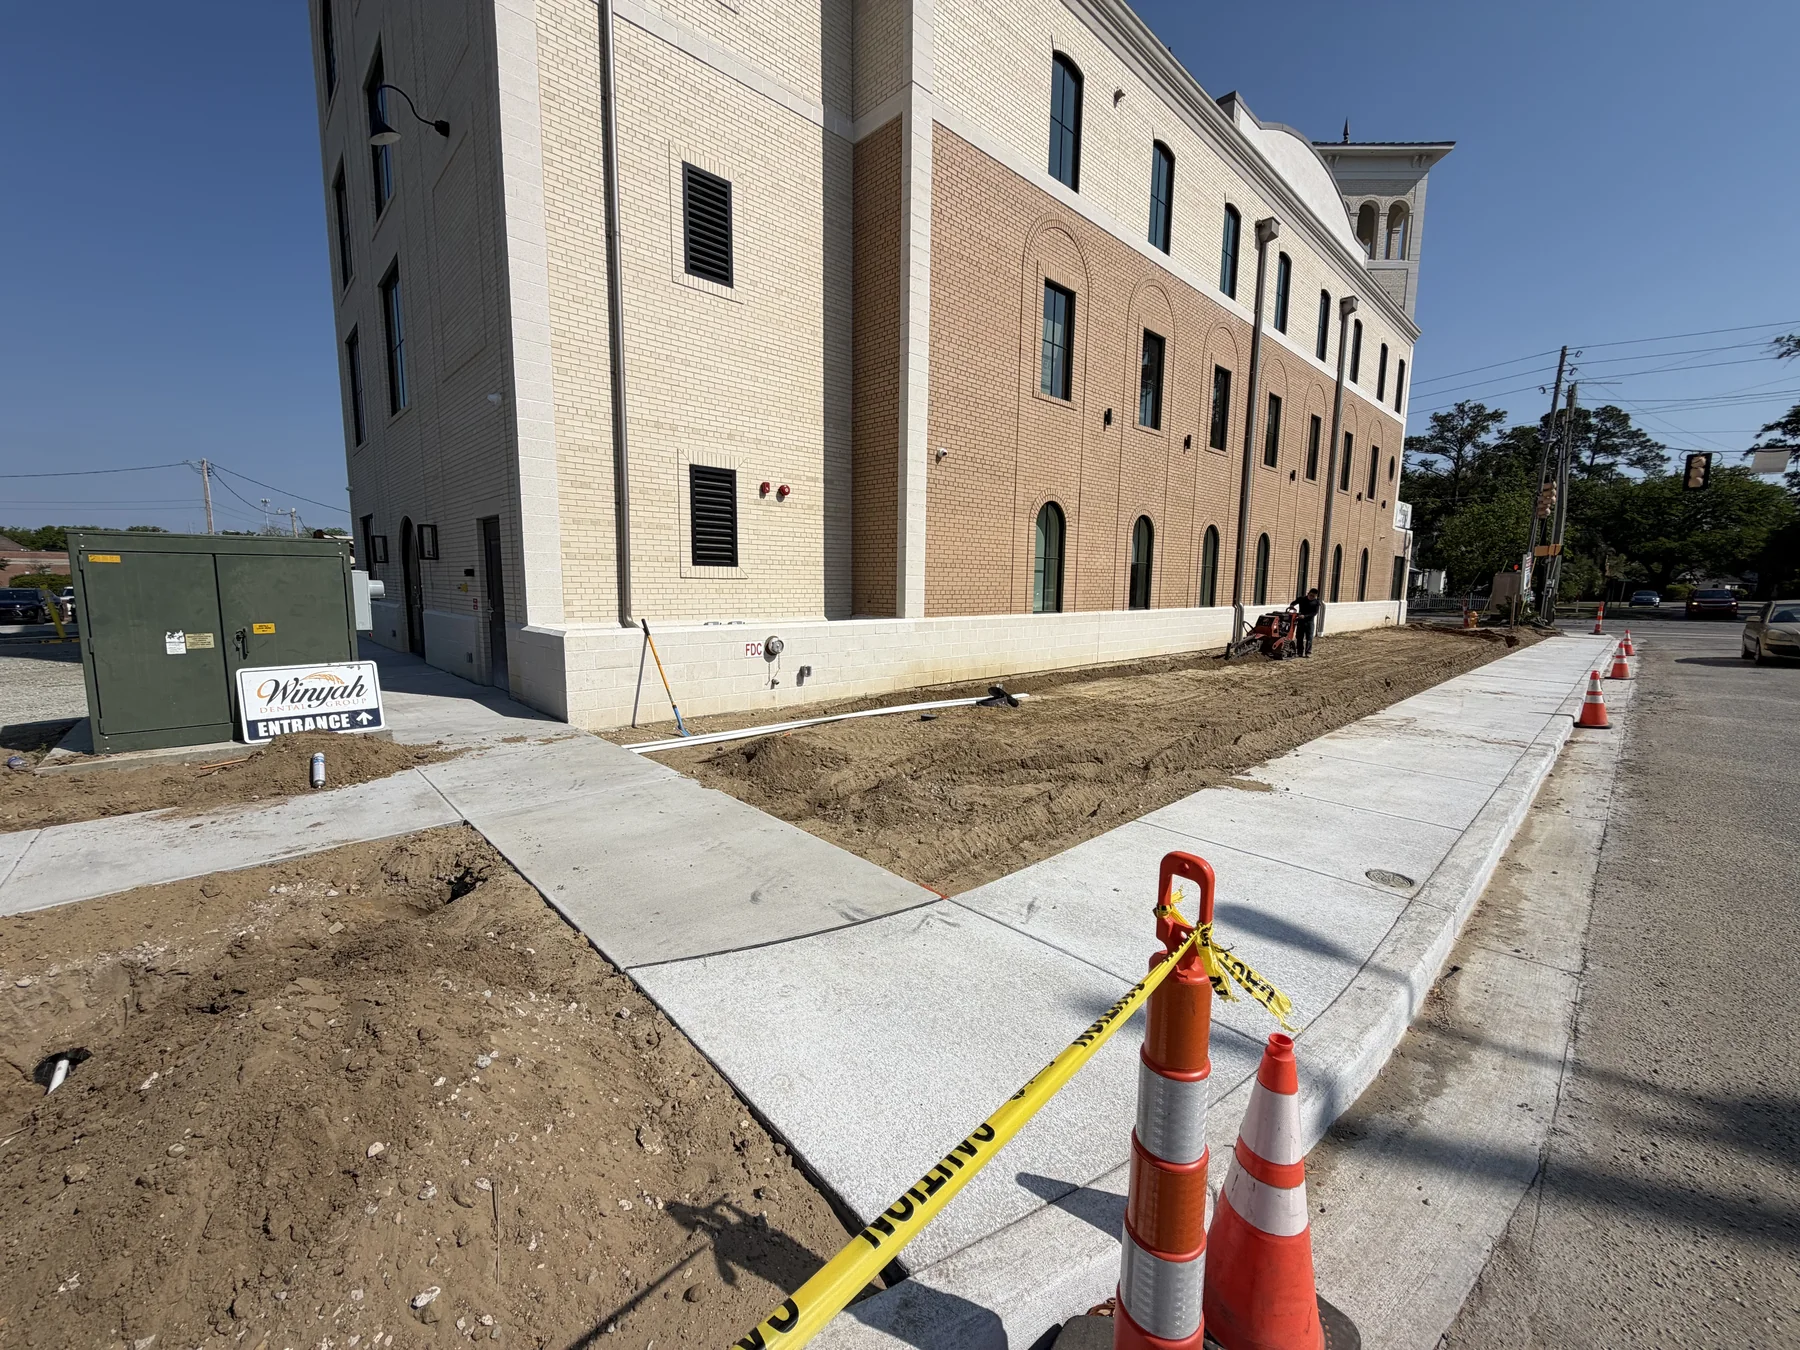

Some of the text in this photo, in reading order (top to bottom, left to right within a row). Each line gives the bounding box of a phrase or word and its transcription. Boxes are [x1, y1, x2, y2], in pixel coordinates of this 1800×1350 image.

[745, 642, 762, 656] FDC
[257, 675, 368, 708] Winyah
[260, 698, 367, 714] DENTAL GROUP
[257, 713, 350, 737] ENTRANCE
[860, 1122, 996, 1249] CAUTION
